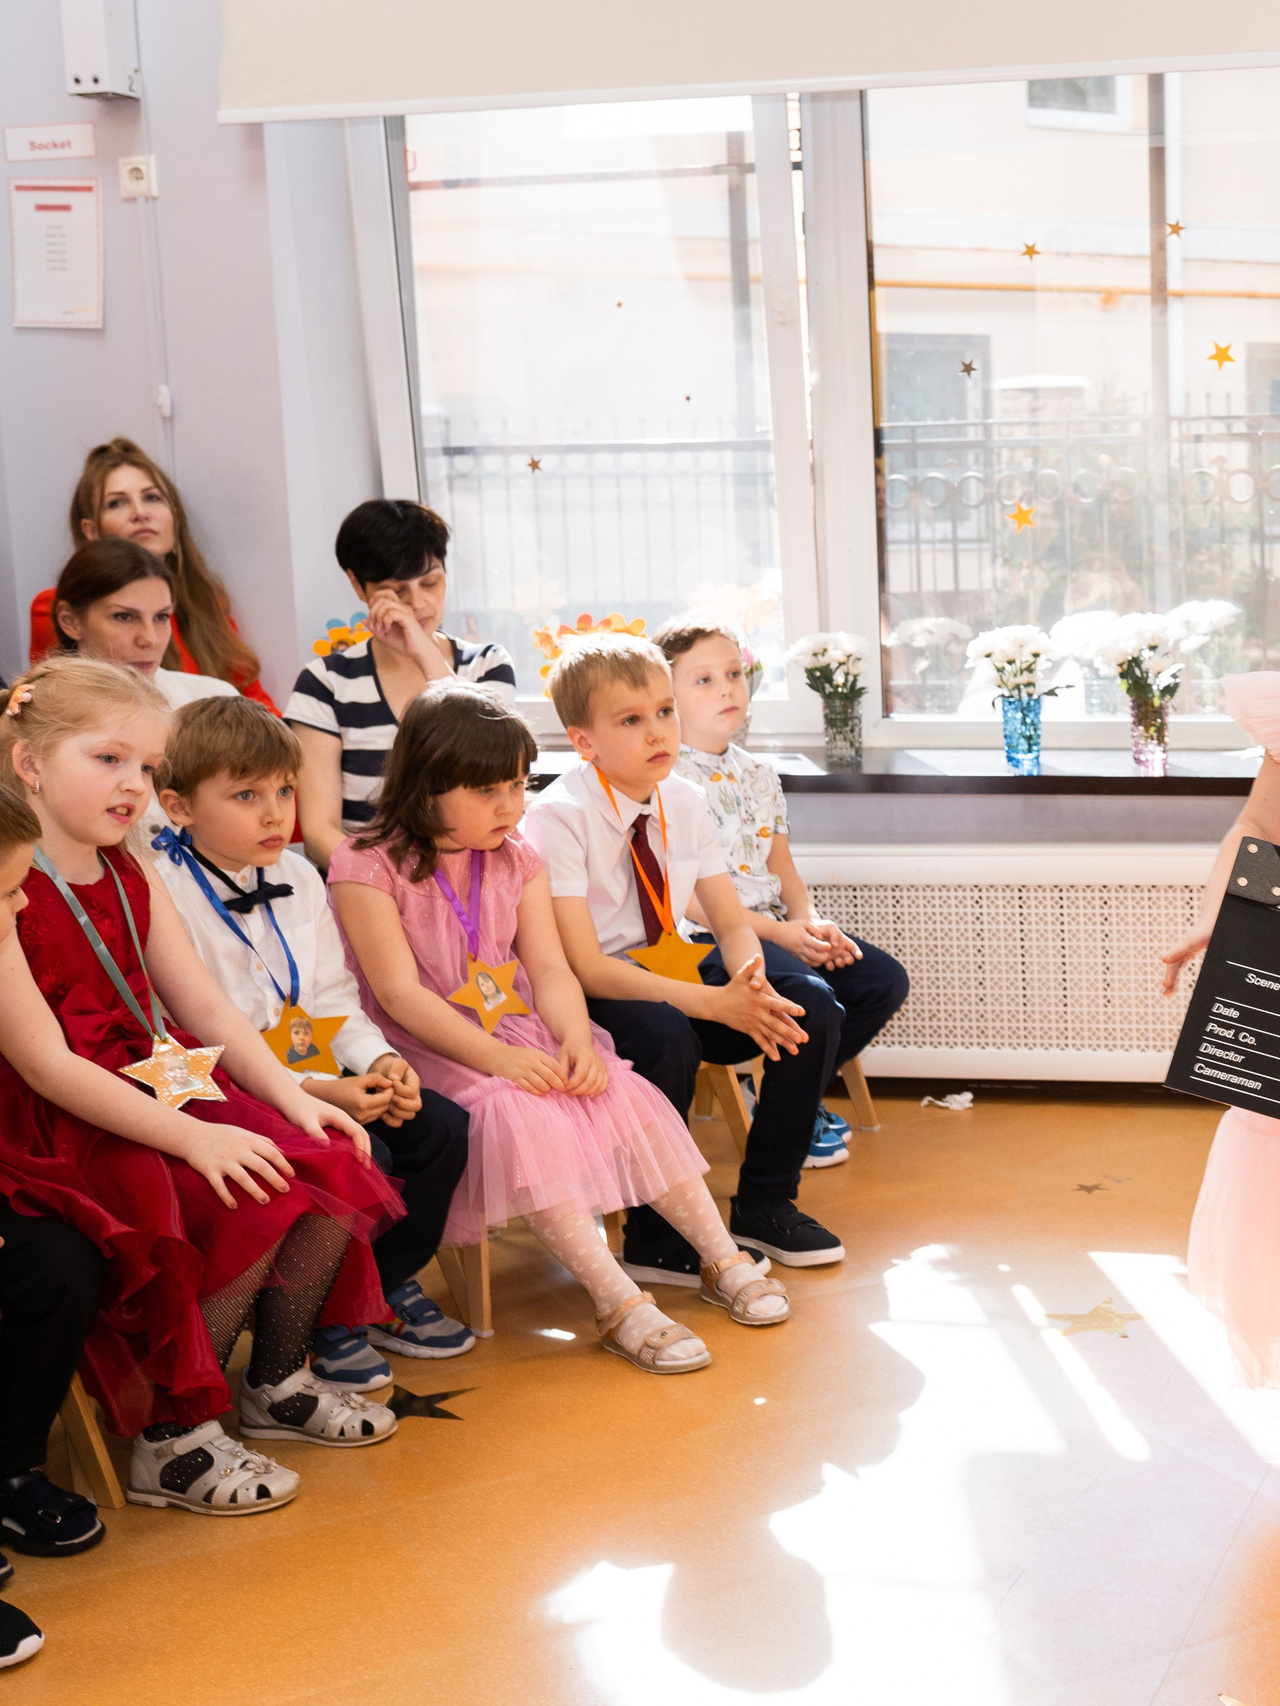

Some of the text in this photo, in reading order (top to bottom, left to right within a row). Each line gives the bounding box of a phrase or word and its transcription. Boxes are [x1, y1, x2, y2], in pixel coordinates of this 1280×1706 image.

[29, 139, 72, 151] Socket
[1245, 974, 1280, 991] Scene
[1211, 1003, 1240, 1019] Date
[1205, 1023, 1257, 1046] Prod. Co.
[1199, 1043, 1245, 1062] Director
[1193, 1063, 1262, 1090] Cameraman
